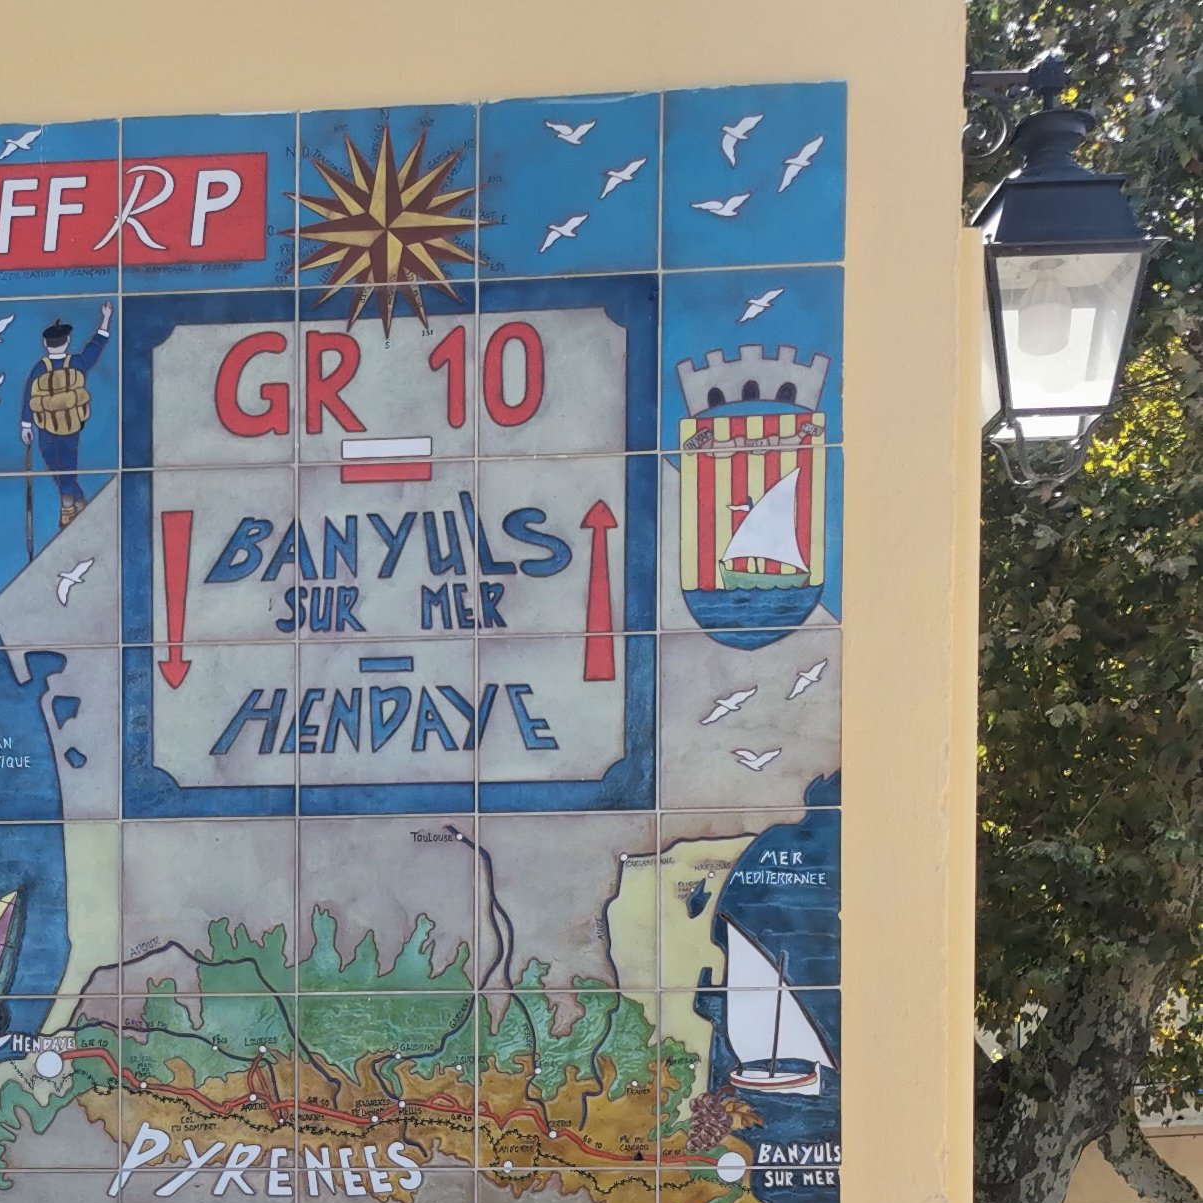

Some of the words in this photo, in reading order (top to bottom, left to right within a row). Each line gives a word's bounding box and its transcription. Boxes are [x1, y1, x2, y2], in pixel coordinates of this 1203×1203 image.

[214, 330, 367, 437] GR
[428, 320, 545, 429] 10
[203, 490, 573, 584] BANYULS
[275, 584, 367, 633] SUR
[421, 582, 508, 630] MER
[209, 683, 560, 756] HENDAYE
[760, 850, 804, 865] MER
[729, 870, 827, 886] MEDITERRANEE
[12, 1034, 76, 1053] HENDAYE
[106, 1121, 424, 1198] PYRENEES
[757, 1143, 841, 1166] BANYULS
[764, 1170, 794, 1188] SUR
[802, 1169, 836, 1186] MER
